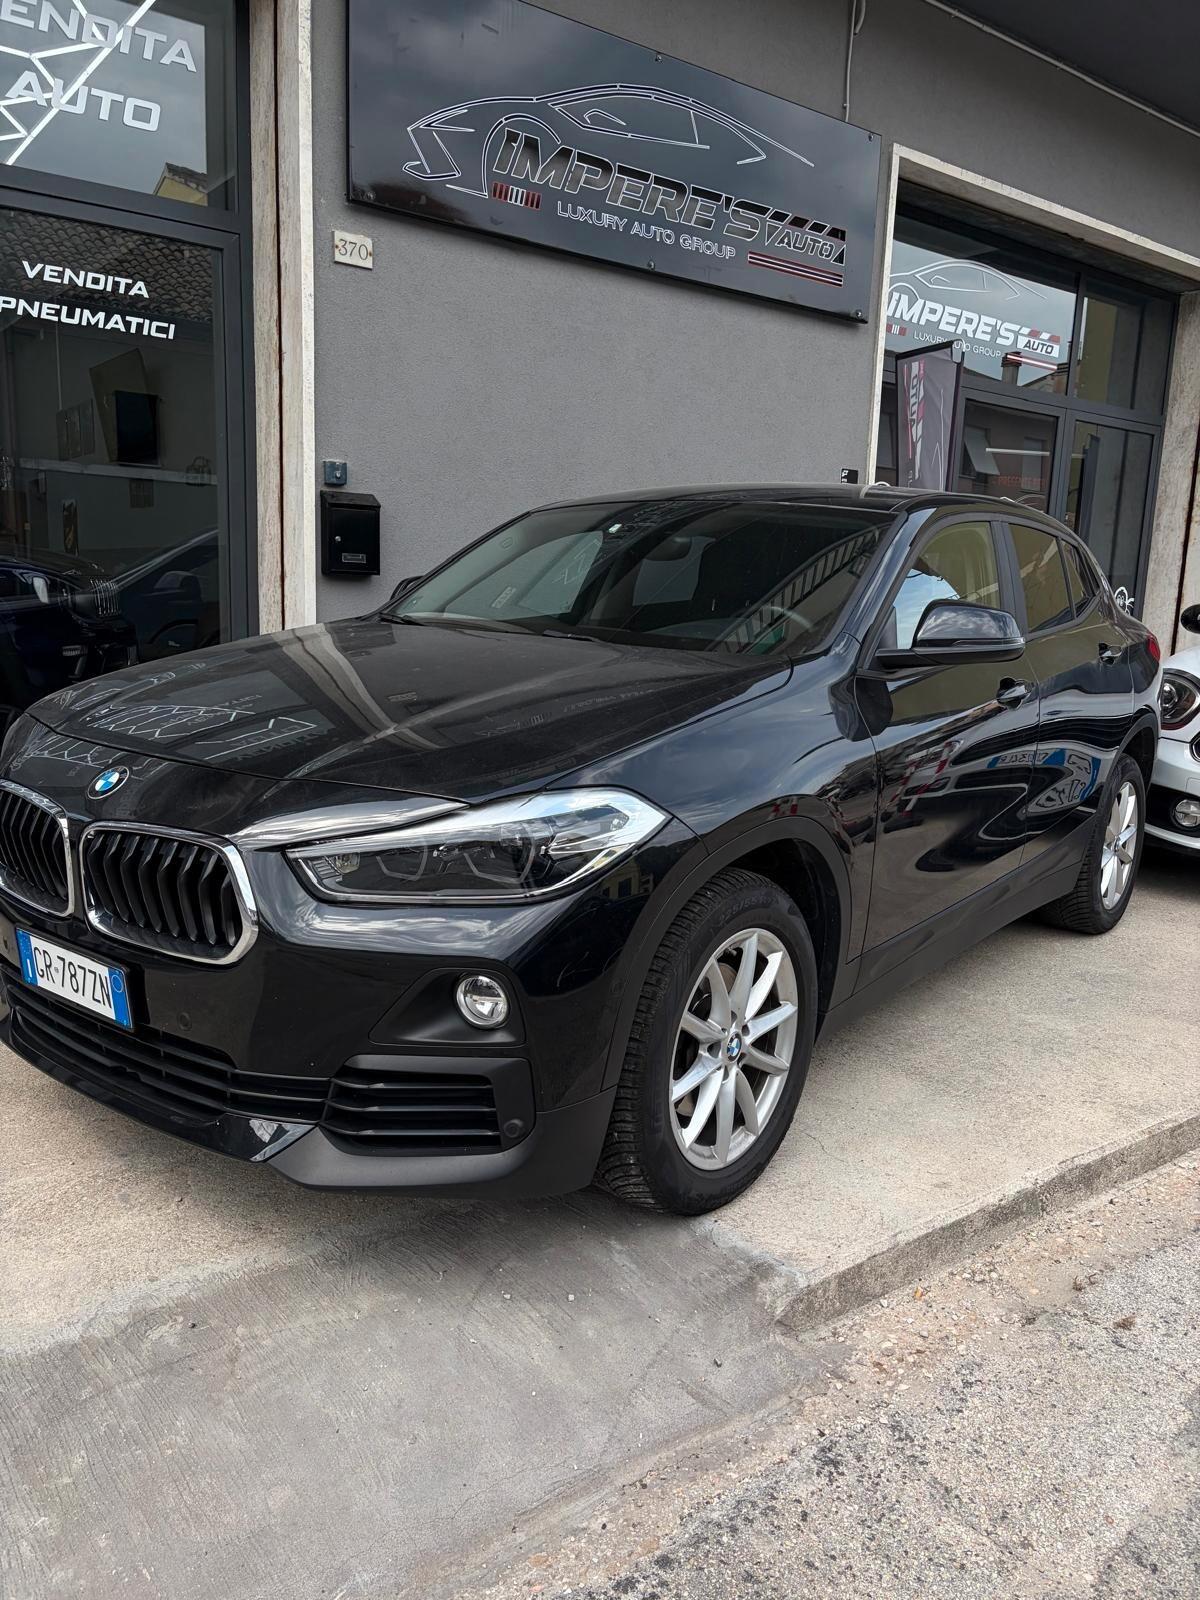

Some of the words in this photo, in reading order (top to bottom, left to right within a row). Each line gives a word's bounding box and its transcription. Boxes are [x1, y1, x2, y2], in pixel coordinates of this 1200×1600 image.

[0, 0, 197, 73] ENDITA
[5, 70, 161, 131] AUTO
[493, 127, 779, 242] IMPERE'S
[338, 238, 369, 261] 370
[557, 200, 628, 232] LUXURY
[630, 221, 676, 245] AUTO
[679, 233, 736, 260] GROUP
[774, 229, 836, 261] AUTO
[22, 260, 149, 299] VENDITA
[0, 295, 176, 341] PNEUMATICI
[886, 291, 1022, 347] IMPERE'S
[972, 345, 1001, 358] GROUP
[1023, 339, 1055, 356] AUTO
[33, 946, 56, 984] GR
[56, 954, 112, 1009] 787ZN
